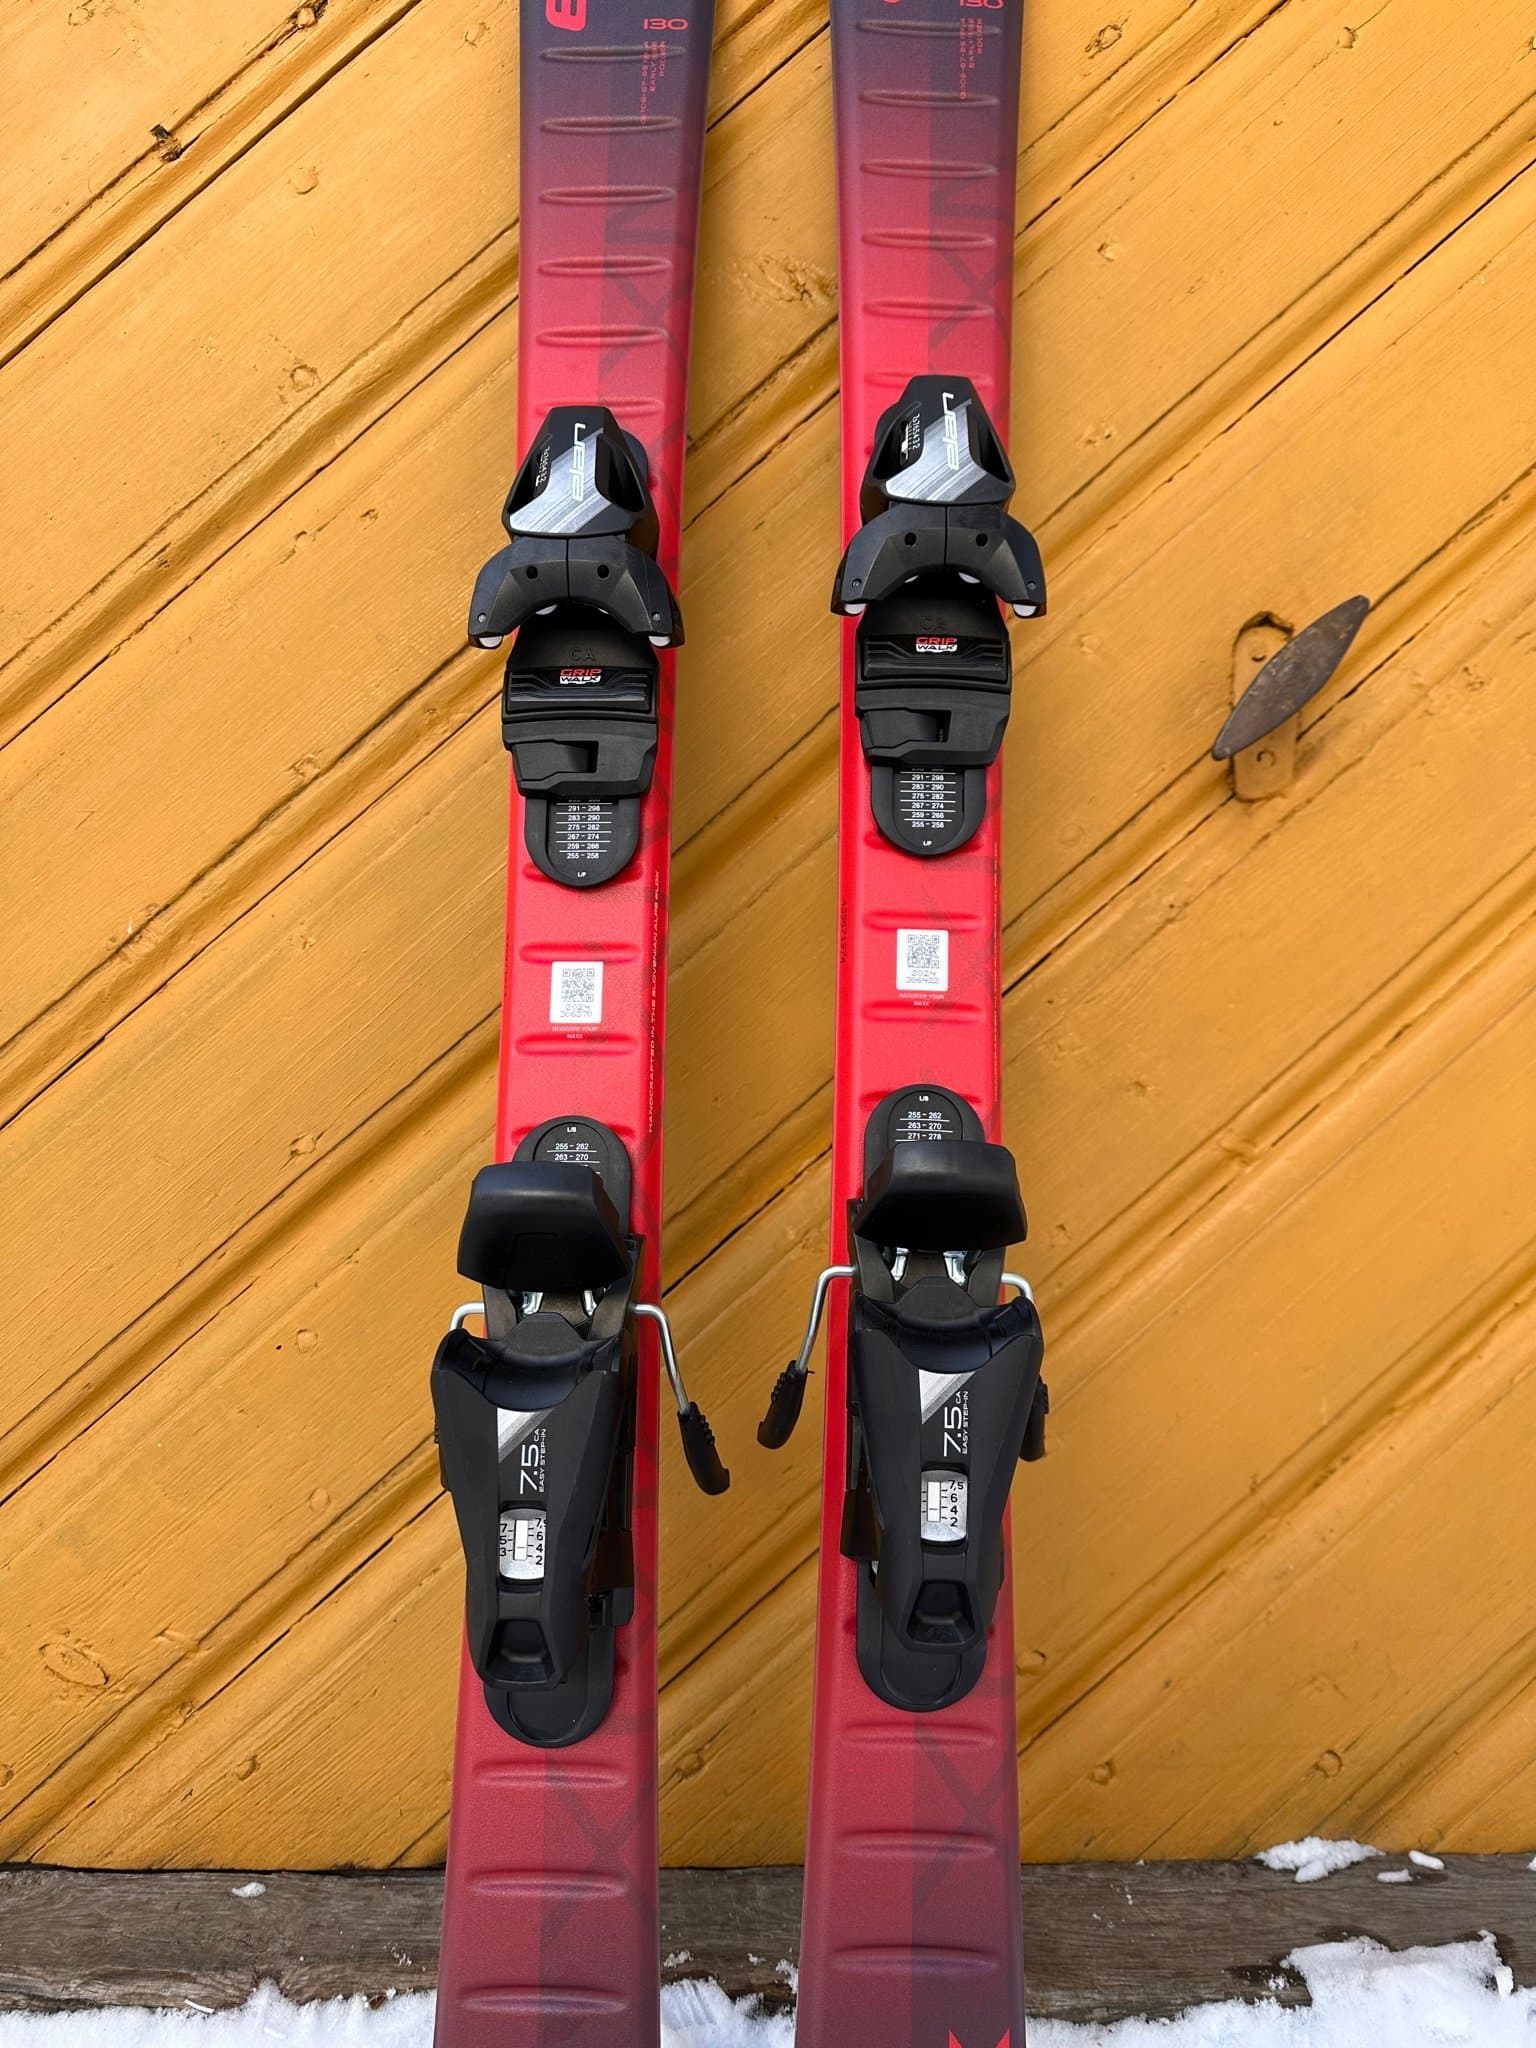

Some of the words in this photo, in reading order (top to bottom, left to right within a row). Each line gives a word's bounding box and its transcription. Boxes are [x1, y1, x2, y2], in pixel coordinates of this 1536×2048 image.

[644, 18, 688, 30] 130
[921, 616, 945, 630] CA
[569, 647, 594, 661] CA
[650, 1026, 655, 1038] IN
[944, 1406, 962, 1457] 7.5
[956, 1391, 961, 1404] CA
[520, 1444, 539, 1495] 7.5
[534, 1428, 540, 1442] CA
[949, 1480, 964, 1491] 7,5
[950, 1493, 958, 1503] 6
[950, 1505, 958, 1515] 4
[950, 1518, 958, 1527] 2
[500, 1523, 508, 1533] 7
[500, 1536, 507, 1545] 5
[536, 1531, 543, 1541] 6
[500, 1547, 506, 1557] 3
[536, 1544, 543, 1553] 4
[536, 1556, 543, 1565] 2
